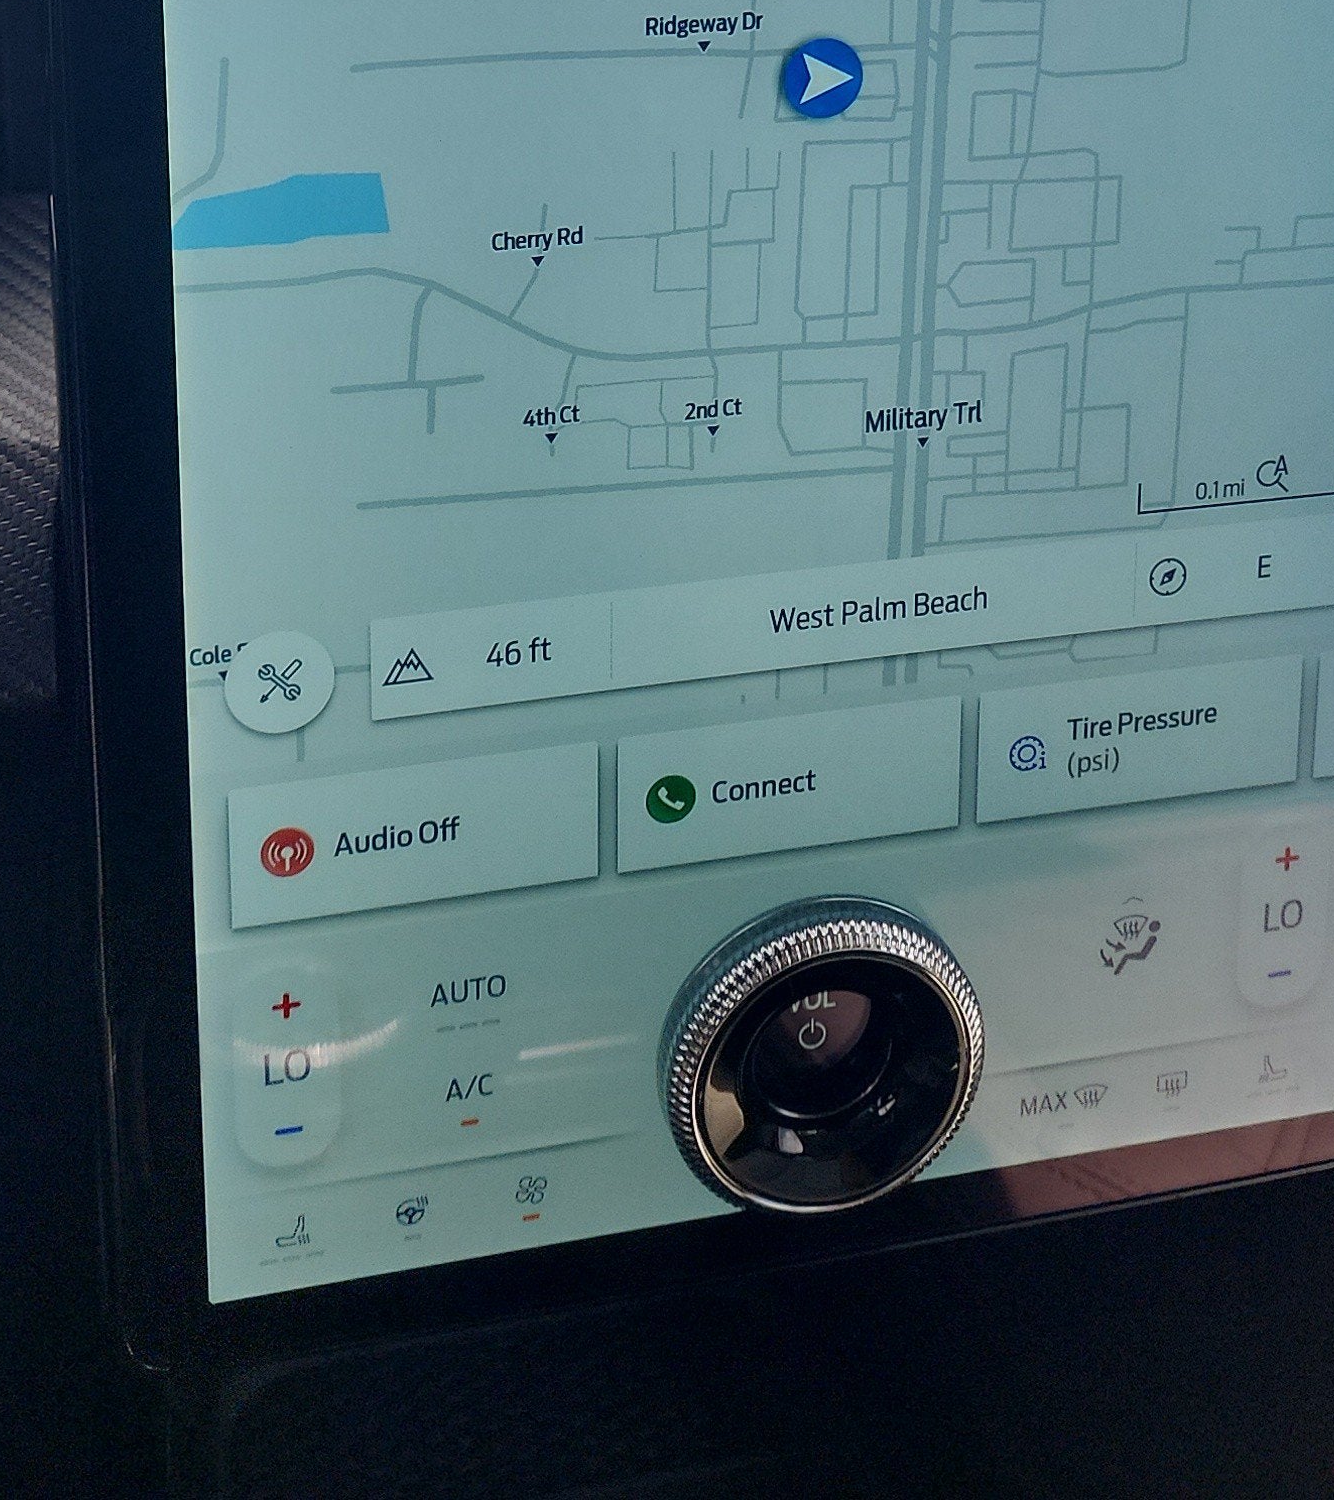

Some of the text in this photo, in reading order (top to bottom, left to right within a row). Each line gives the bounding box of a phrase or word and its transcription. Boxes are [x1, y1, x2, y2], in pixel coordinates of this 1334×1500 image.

[645, 11, 764, 38] Ridgeway Dr
[491, 225, 583, 252] Cherry Rd
[523, 405, 580, 426] 4th Ct
[684, 398, 743, 420] 2nd Ct
[865, 399, 982, 433] Military Trl
[1258, 555, 1272, 578] E
[770, 586, 989, 633] West Palm Beach
[189, 644, 233, 666] Cole
[485, 637, 552, 668] 46 ft
[1067, 706, 1218, 741] Tire Pressure
[1067, 748, 1120, 779] (psi)
[711, 769, 817, 803] Connect
[334, 816, 461, 857] Audio Off
[1263, 899, 1303, 933] LO
[430, 974, 507, 1007] AUTO
[263, 1049, 311, 1086] LO
[445, 1073, 494, 1102] A/C
[1020, 1092, 1067, 1116] MAX
